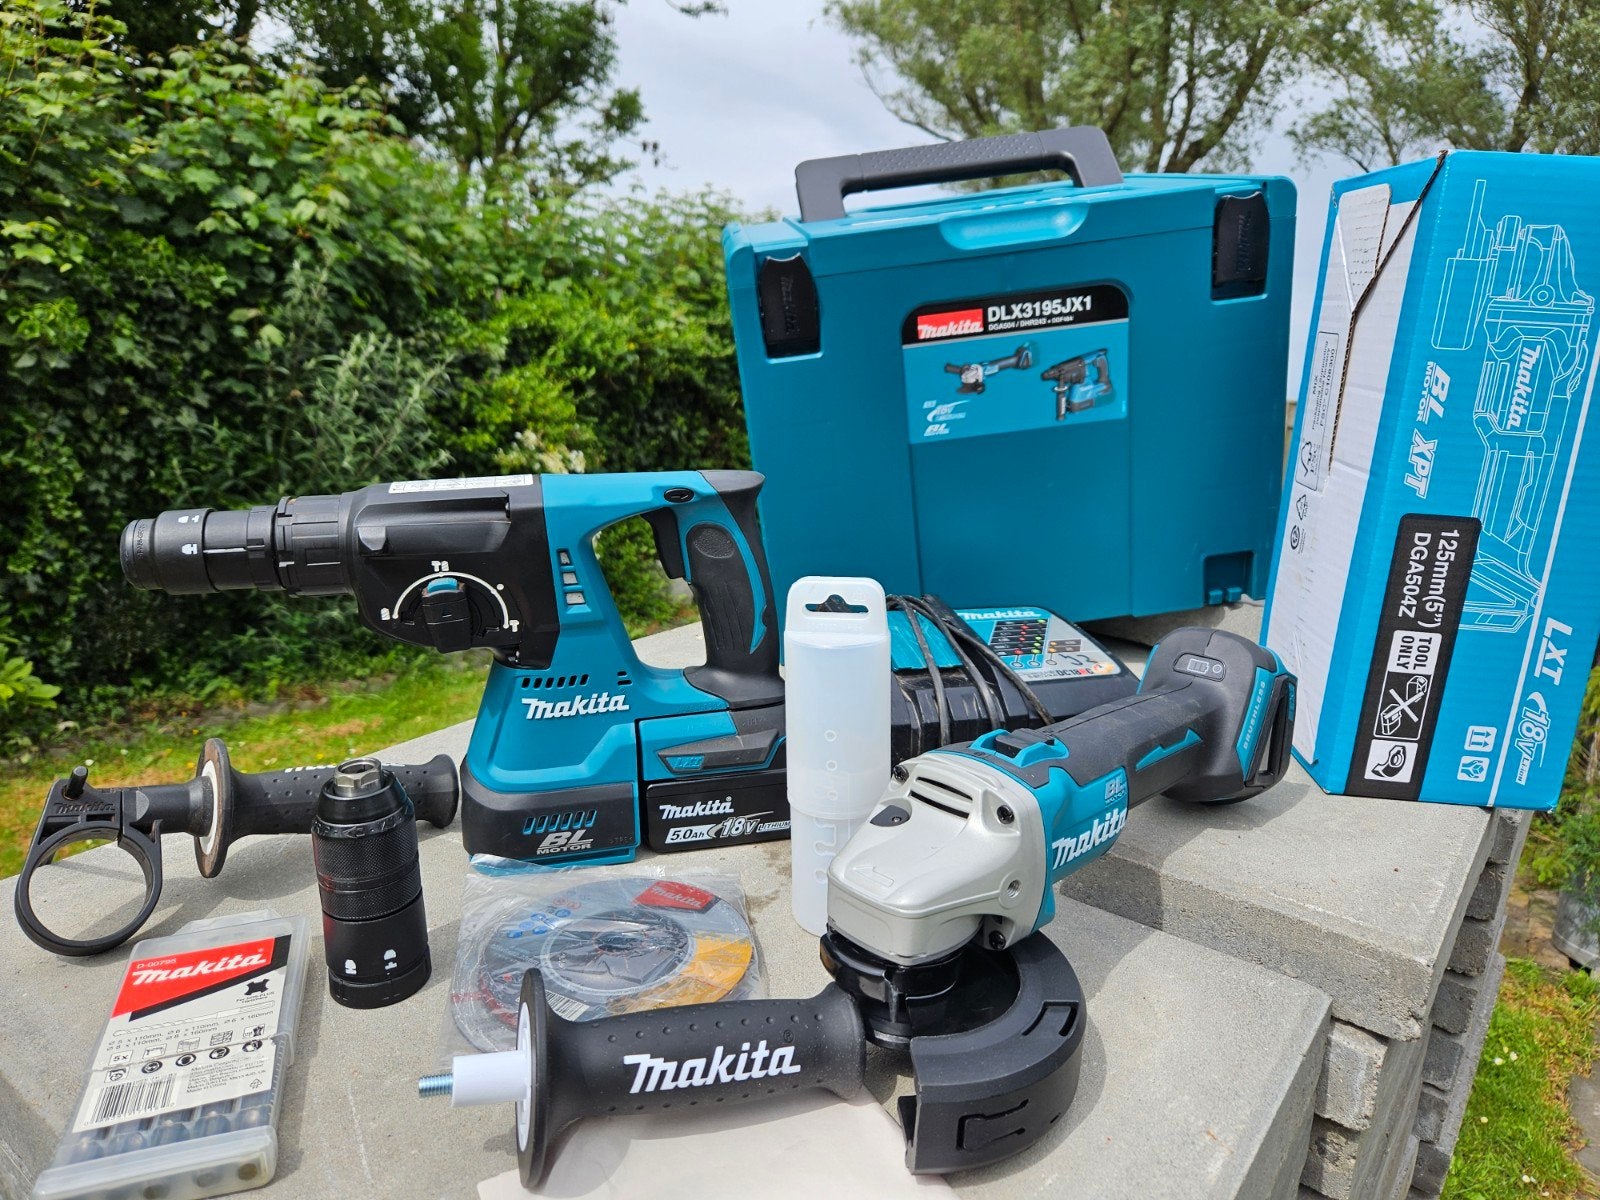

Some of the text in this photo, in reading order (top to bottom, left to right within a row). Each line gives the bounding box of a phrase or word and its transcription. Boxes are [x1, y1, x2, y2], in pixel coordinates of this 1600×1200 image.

[918, 295, 1093, 340] Makita DLX3195JX1
[1416, 361, 1434, 422] MOTOR
[1506, 345, 1541, 430] Makita
[1404, 365, 1451, 499] BL XPT
[1398, 532, 1432, 618] DGA504Z
[959, 610, 1041, 621] Makita
[1397, 635, 1414, 670] ONLY
[1413, 637, 1432, 671] TOOL
[1534, 616, 1573, 686] LXT
[522, 692, 630, 720] Makita
[1243, 681, 1266, 750] BRUSHLESS
[1105, 775, 1126, 800] BL
[54, 801, 116, 815] Makita
[660, 799, 734, 820] Makita
[540, 829, 594, 848] BL
[670, 828, 705, 841] 5.0Ah
[720, 816, 760, 839] 18V
[1051, 807, 1128, 870] Makita
[536, 843, 592, 855] MOTOR
[652, 885, 702, 907] Makita
[132, 953, 267, 986] Makita
[136, 958, 177, 969] D-00795
[622, 1038, 801, 1094] Makita
